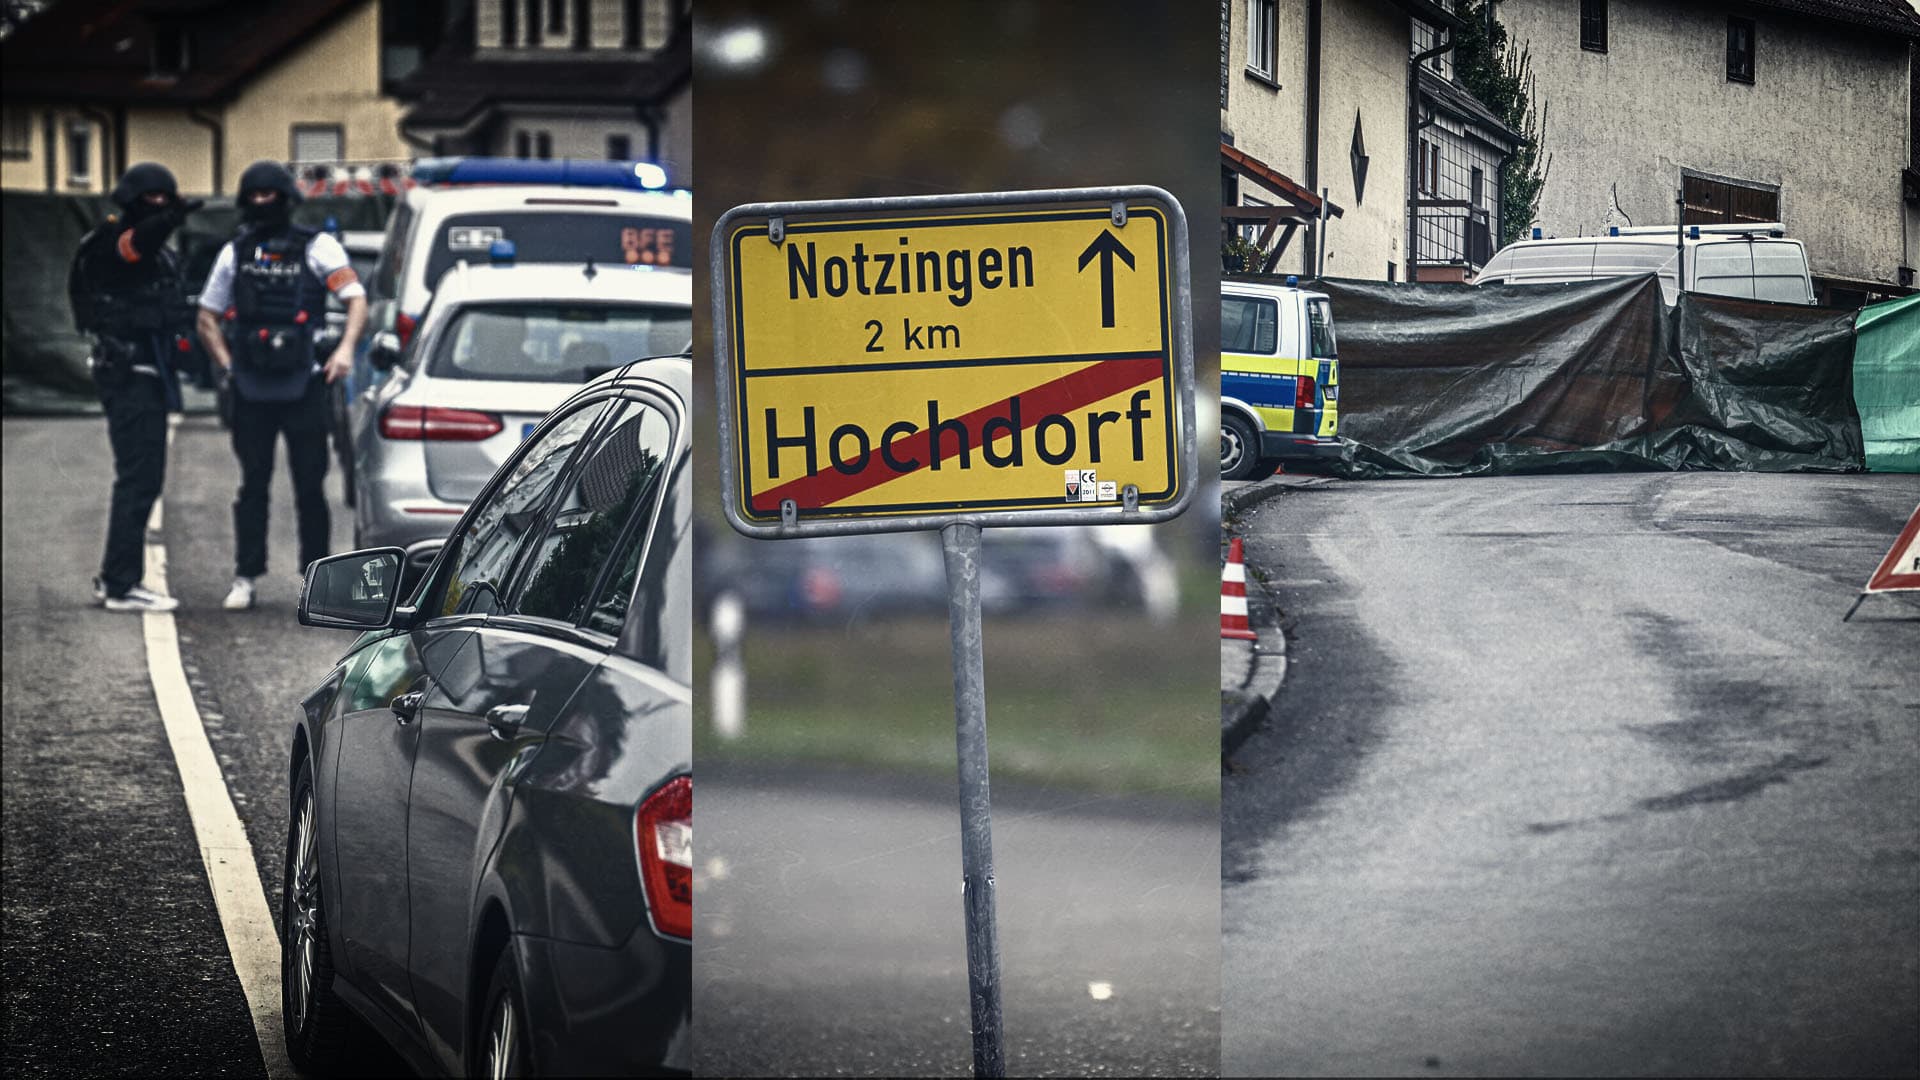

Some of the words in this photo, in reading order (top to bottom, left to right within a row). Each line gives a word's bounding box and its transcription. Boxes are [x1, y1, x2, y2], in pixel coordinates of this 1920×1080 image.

[787, 236, 1035, 308] Notzingen
[864, 319, 885, 353] 2
[903, 317, 961, 350] km
[764, 389, 1152, 479] Hochdorf
